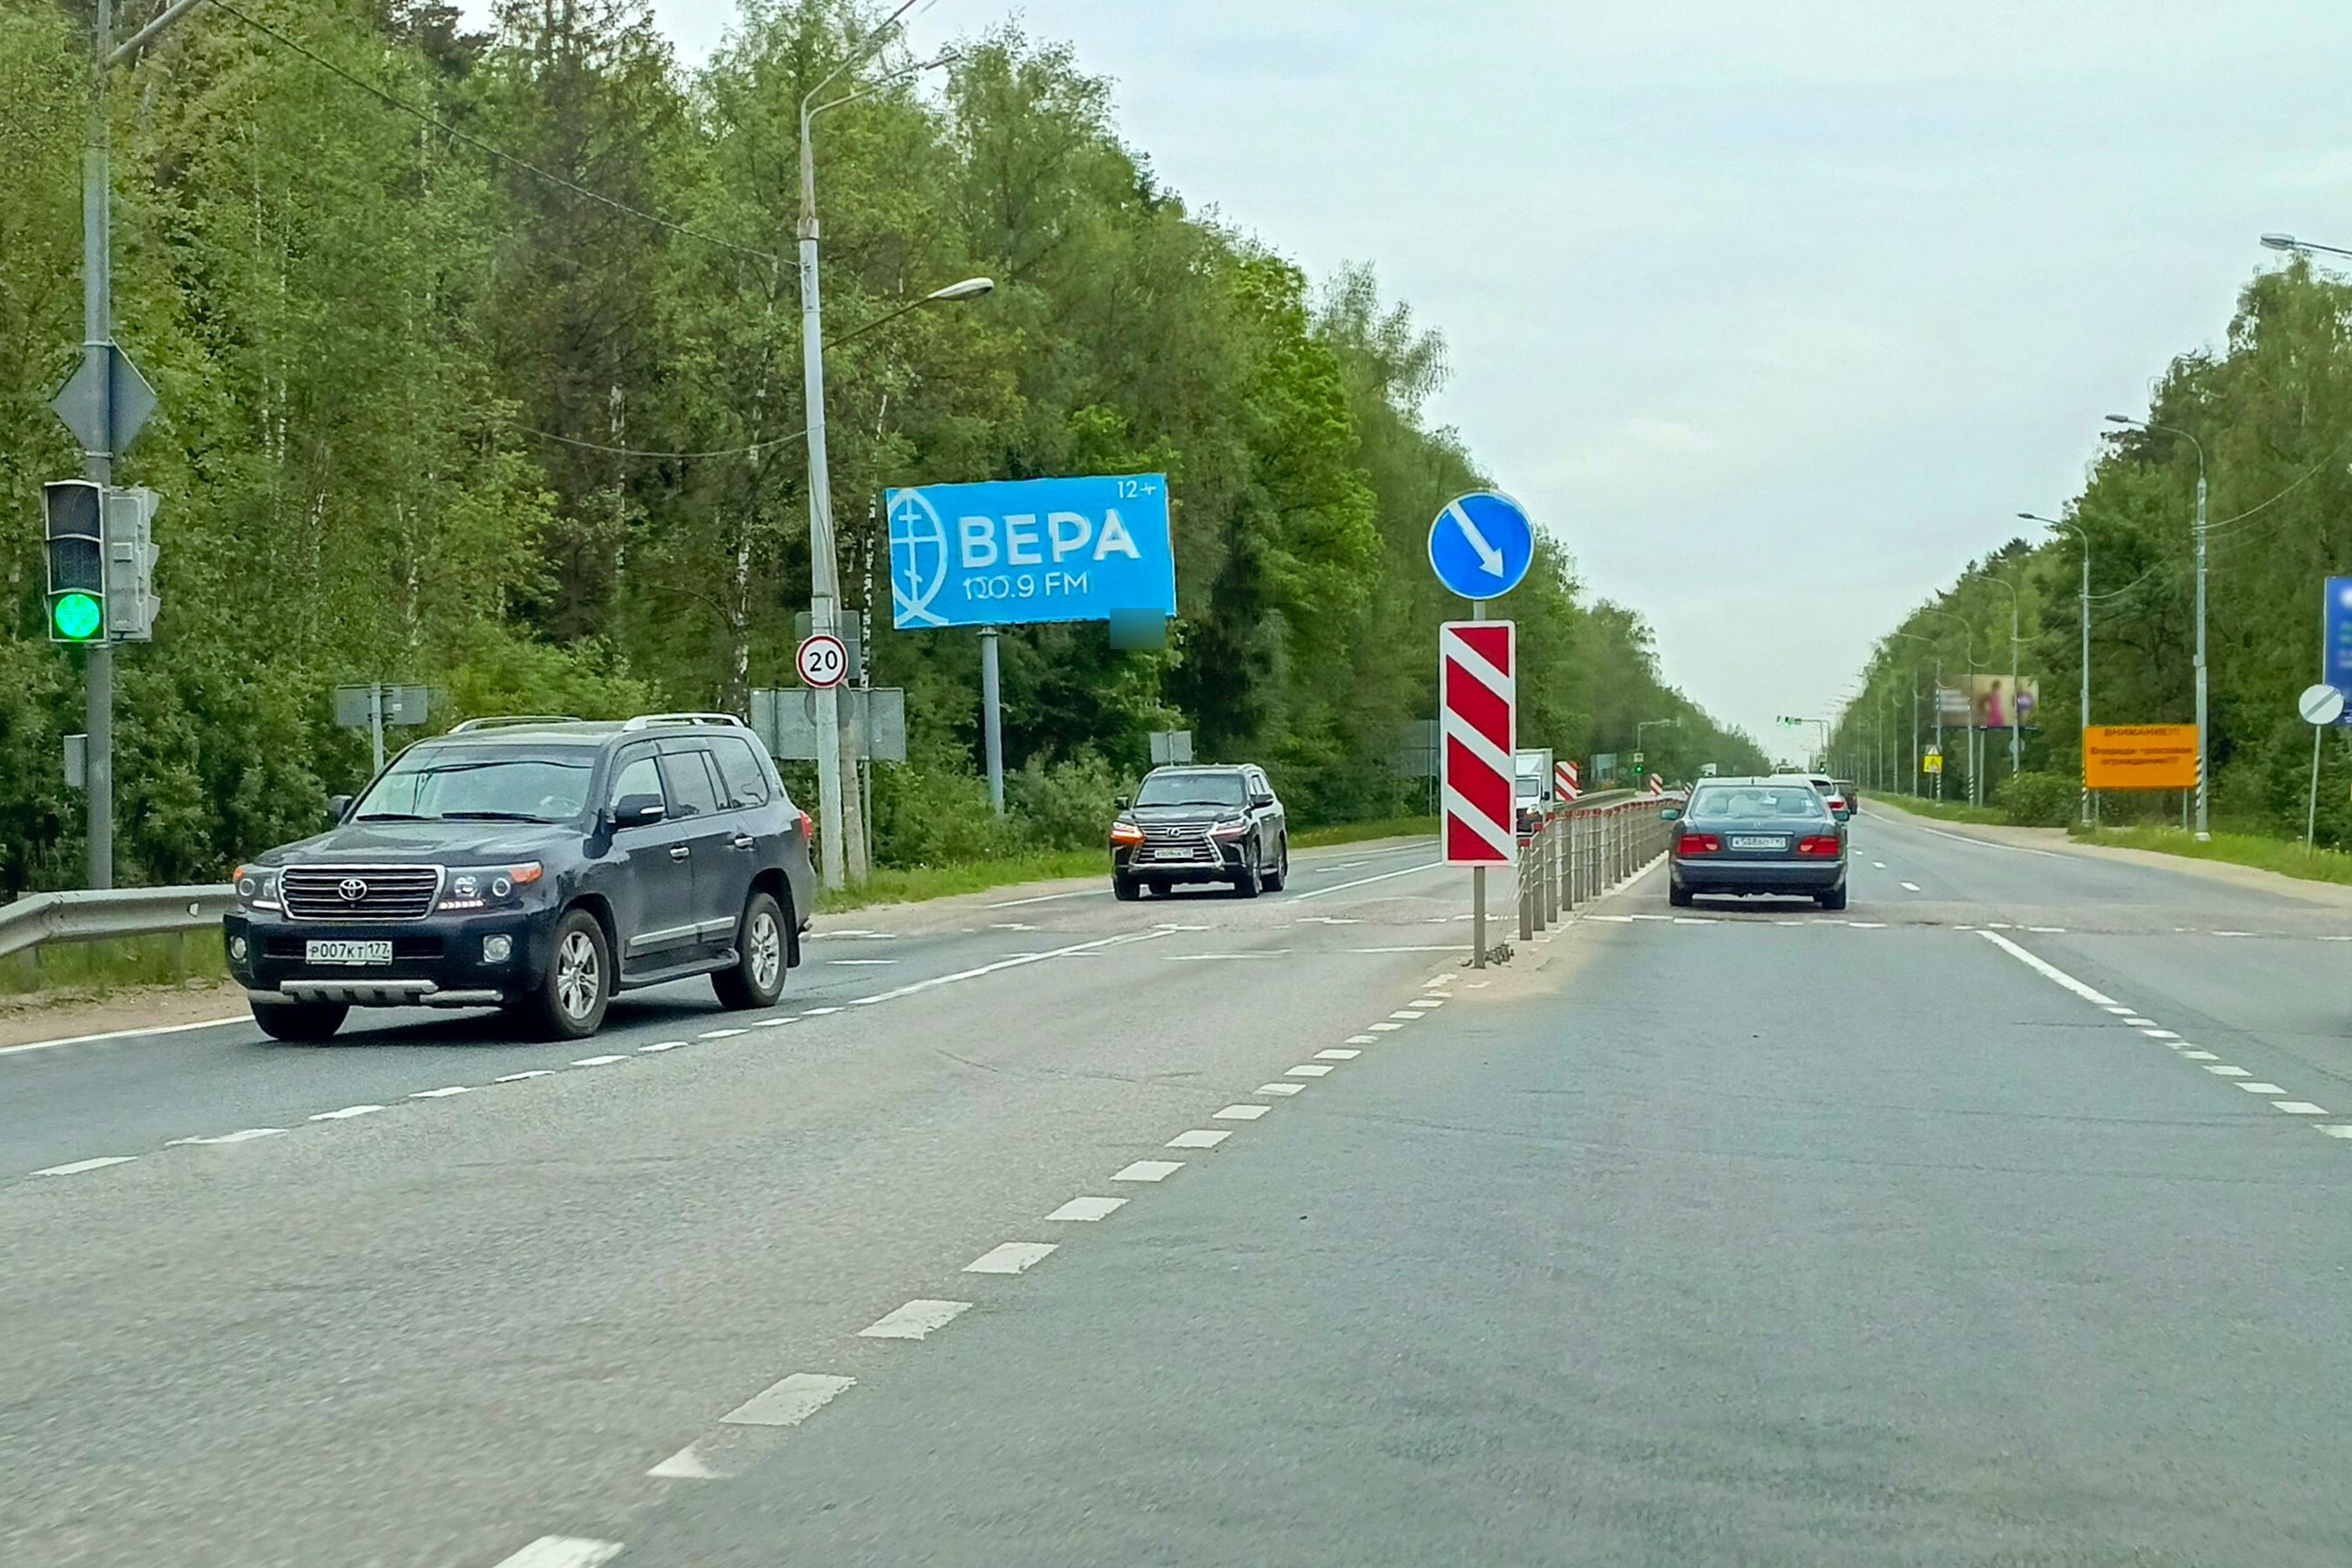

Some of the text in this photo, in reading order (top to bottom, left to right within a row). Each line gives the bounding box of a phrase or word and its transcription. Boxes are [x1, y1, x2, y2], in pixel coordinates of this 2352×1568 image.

[1118, 480, 1157, 498] 12+
[959, 508, 1142, 569] ВЕРА
[963, 571, 1088, 600] 100.9 FM
[809, 650, 838, 672] 20
